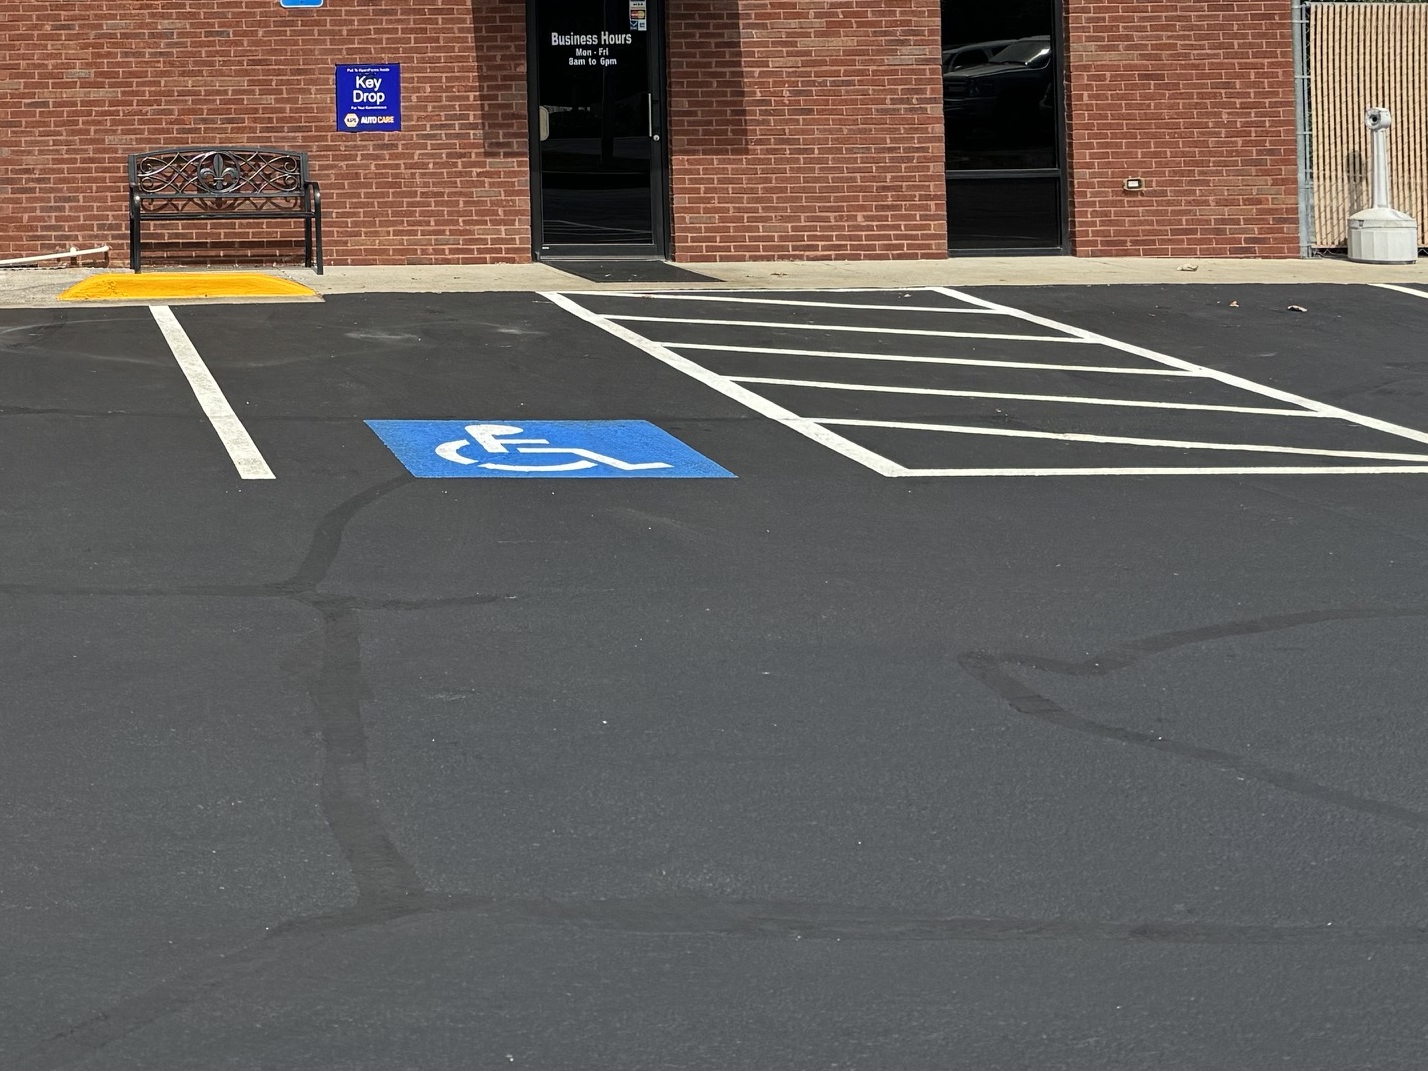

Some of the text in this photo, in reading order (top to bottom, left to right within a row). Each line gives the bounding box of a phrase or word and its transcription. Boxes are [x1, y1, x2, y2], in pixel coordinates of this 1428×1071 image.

[551, 31, 632, 46] Business Hours
[575, 48, 592, 57] Mon
[598, 47, 609, 56] Fri
[568, 57, 617, 67] 8am to 6pm
[355, 75, 382, 91] Key
[353, 90, 385, 105] Drop
[361, 116, 377, 124] AUTO
[378, 116, 394, 124] CARE
